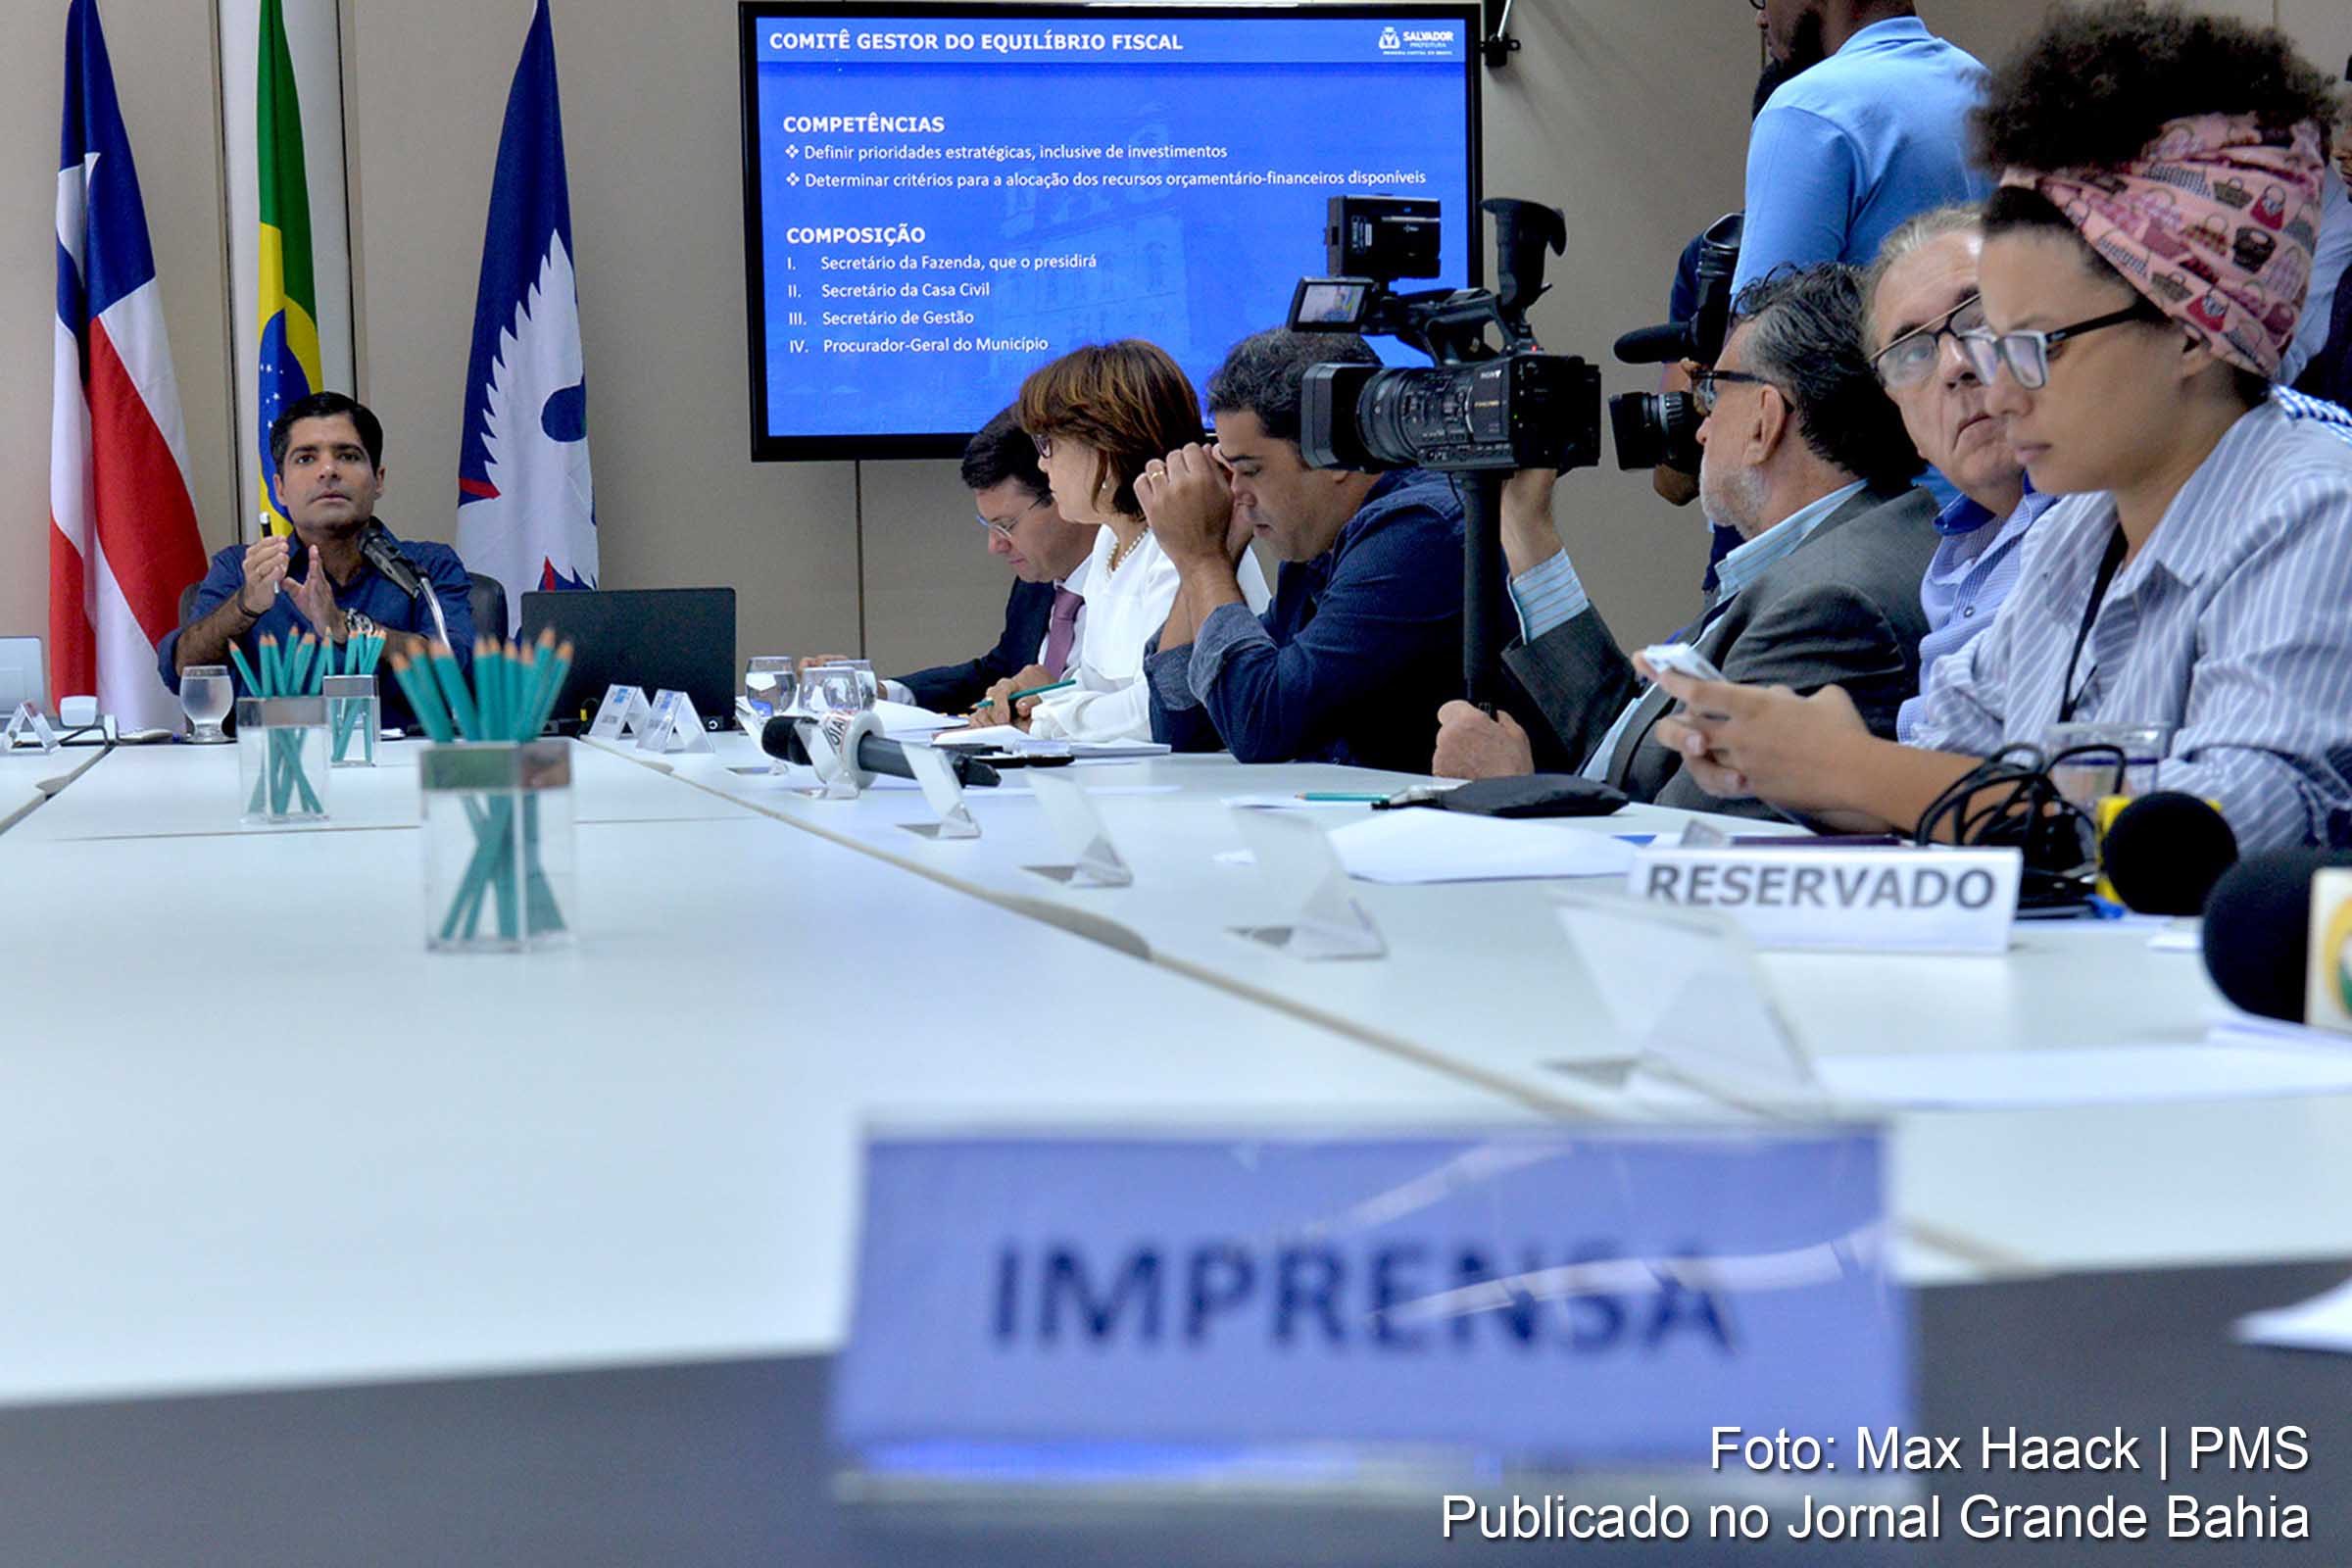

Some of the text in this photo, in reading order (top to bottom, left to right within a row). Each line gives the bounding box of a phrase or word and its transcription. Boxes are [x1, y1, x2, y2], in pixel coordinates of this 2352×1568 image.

[769, 28, 1184, 54] COMITÊ GESTOR DO EQUILÍBRIO FISCAL
[1402, 30, 1454, 42] SALVADOR
[783, 112, 946, 133] COMPETÊNCIAS
[804, 144, 1228, 162] Definir prioridades estratégicas, inclusive de investimentos
[805, 170, 1427, 189] Determinar critérios para a alocação dos recursos orçamentário-financeiros disponíveis
[786, 223, 926, 247] COMPOSIÇÃO
[787, 253, 1098, 271] I. Secretário da Fazenda, que o presidirá
[788, 281, 991, 298] II. Secretário da Casa Civil
[789, 309, 974, 326] III. Secretário de Gestão
[790, 336, 1049, 354] IV. Procurador-Geral do Município
[1646, 863, 1996, 910] RESERVADO
[988, 1240, 1736, 1353] IMPRENSA
